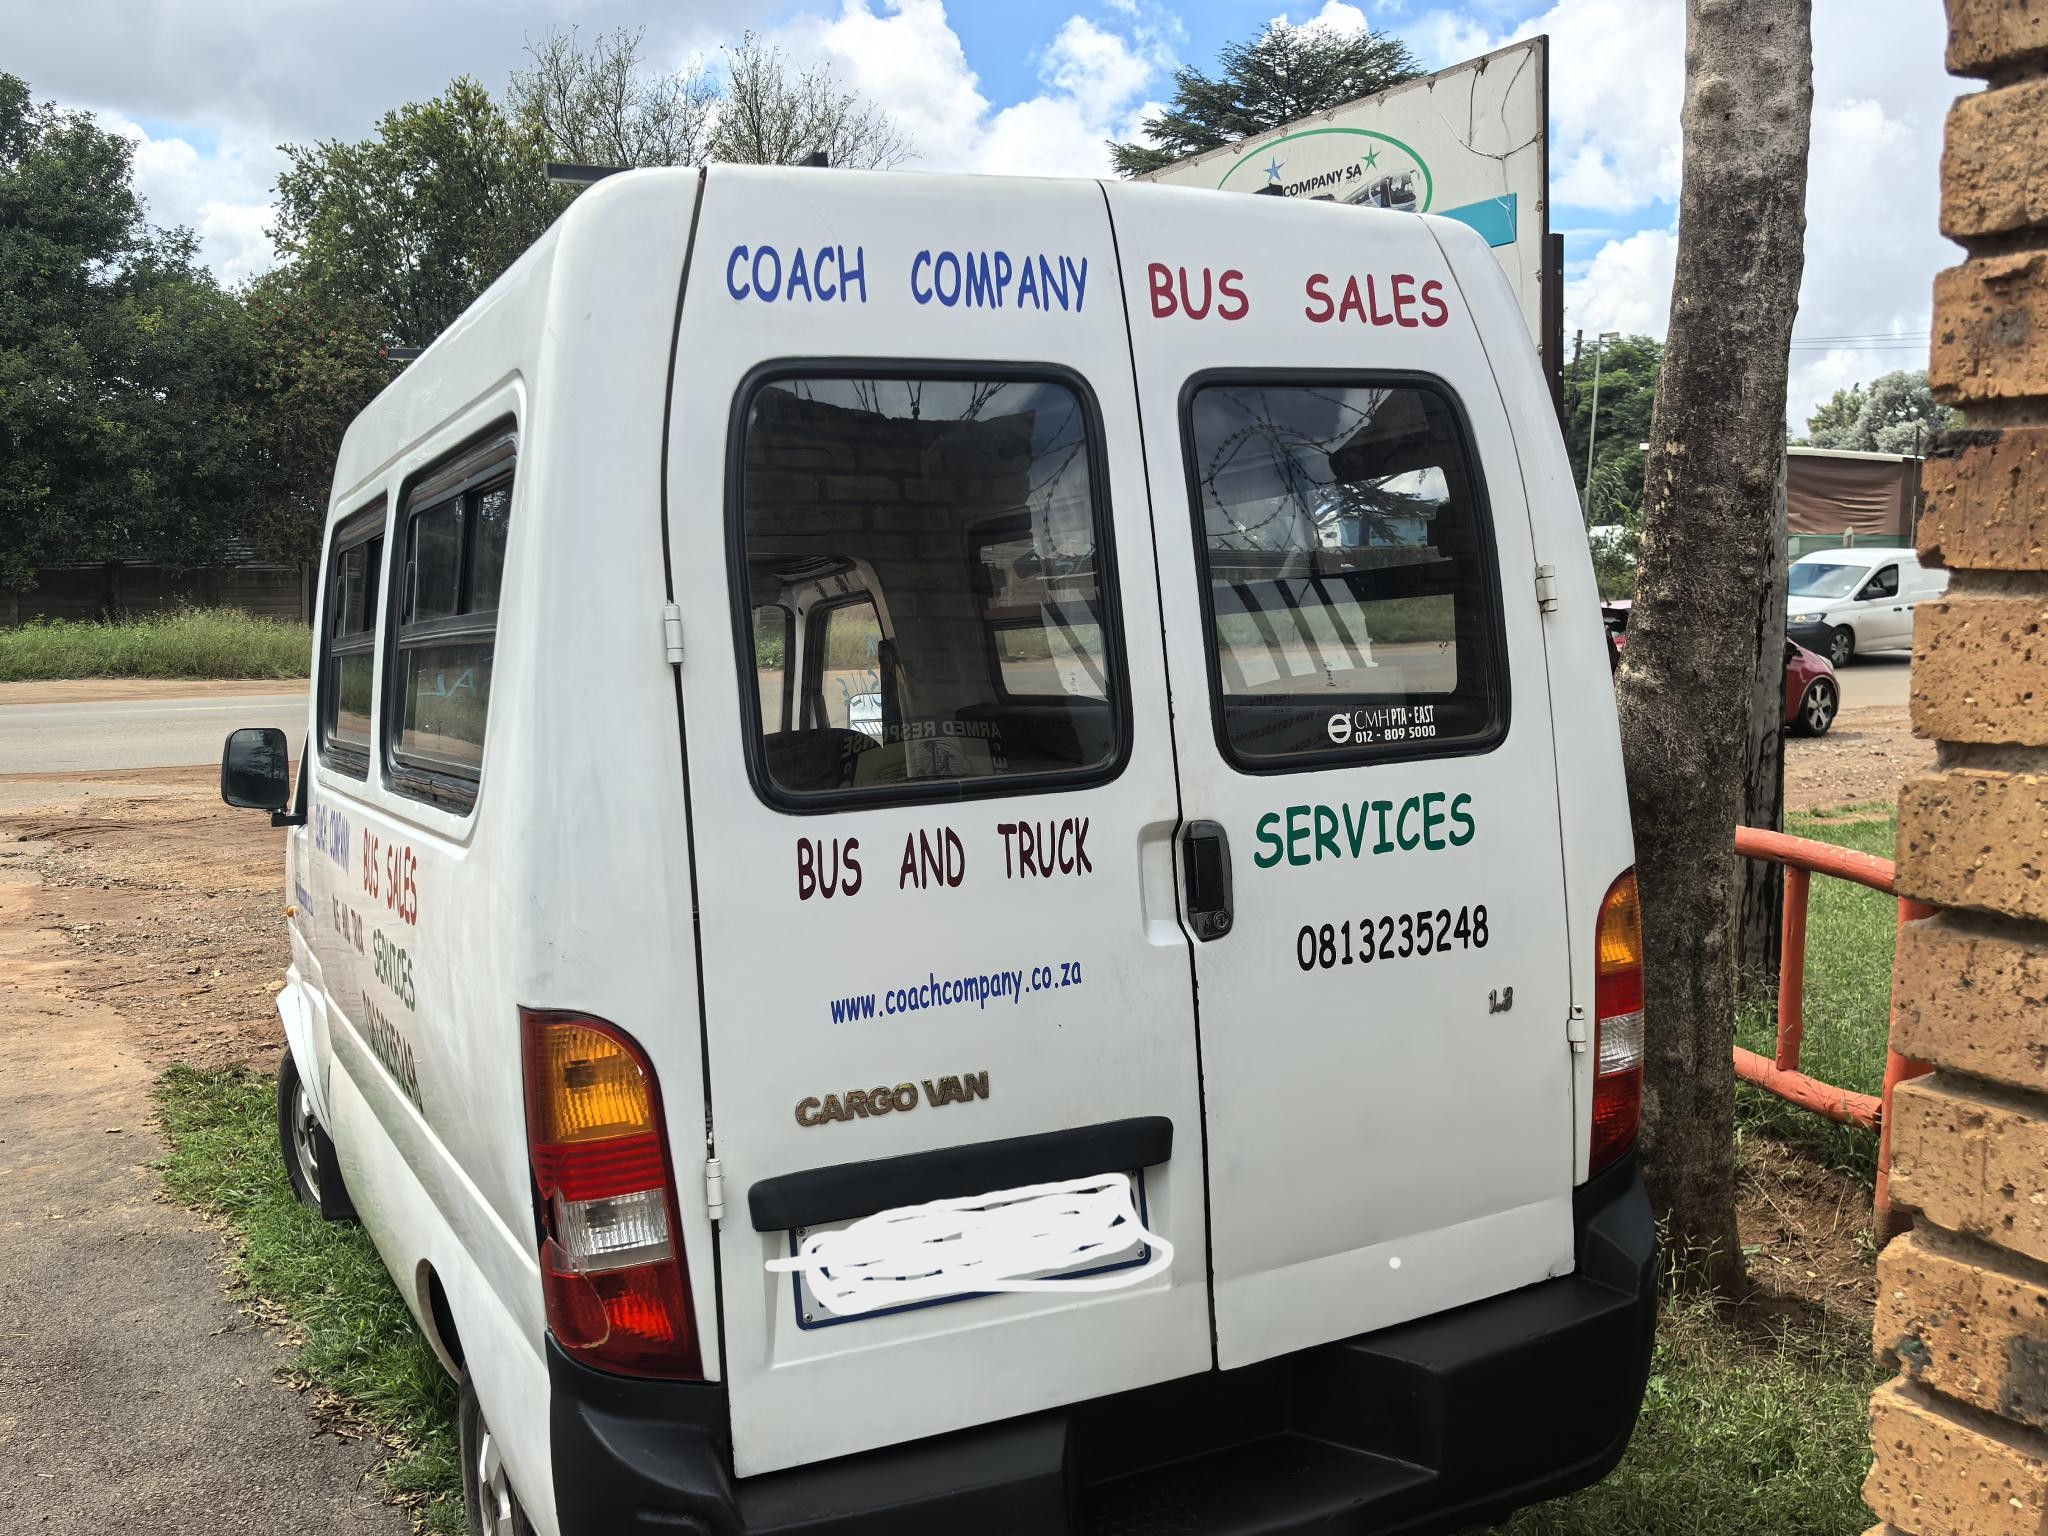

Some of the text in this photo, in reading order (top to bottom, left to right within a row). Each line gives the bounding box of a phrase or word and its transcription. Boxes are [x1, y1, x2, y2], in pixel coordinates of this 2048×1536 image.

[1283, 163, 1362, 198] COMPANY SA
[726, 244, 1088, 313] COACH COMPANY
[1148, 262, 1449, 328] BUS SALES
[1354, 708, 1390, 730] CMH
[1414, 704, 1434, 724] EAST
[1355, 730, 1374, 744] 012
[1384, 727, 1406, 741] 809
[1409, 724, 1436, 739] 5000
[797, 816, 1093, 901] BUS AND TRUCK
[1253, 791, 1476, 869] SERVICES
[363, 827, 380, 899] BUS
[386, 843, 418, 926] SALES
[373, 928, 416, 1013] SERVICES
[1297, 904, 1489, 972] 0813235248
[830, 961, 1082, 1025] www.coachcompany.co.za
[794, 1069, 990, 1128] CARGO VAN
